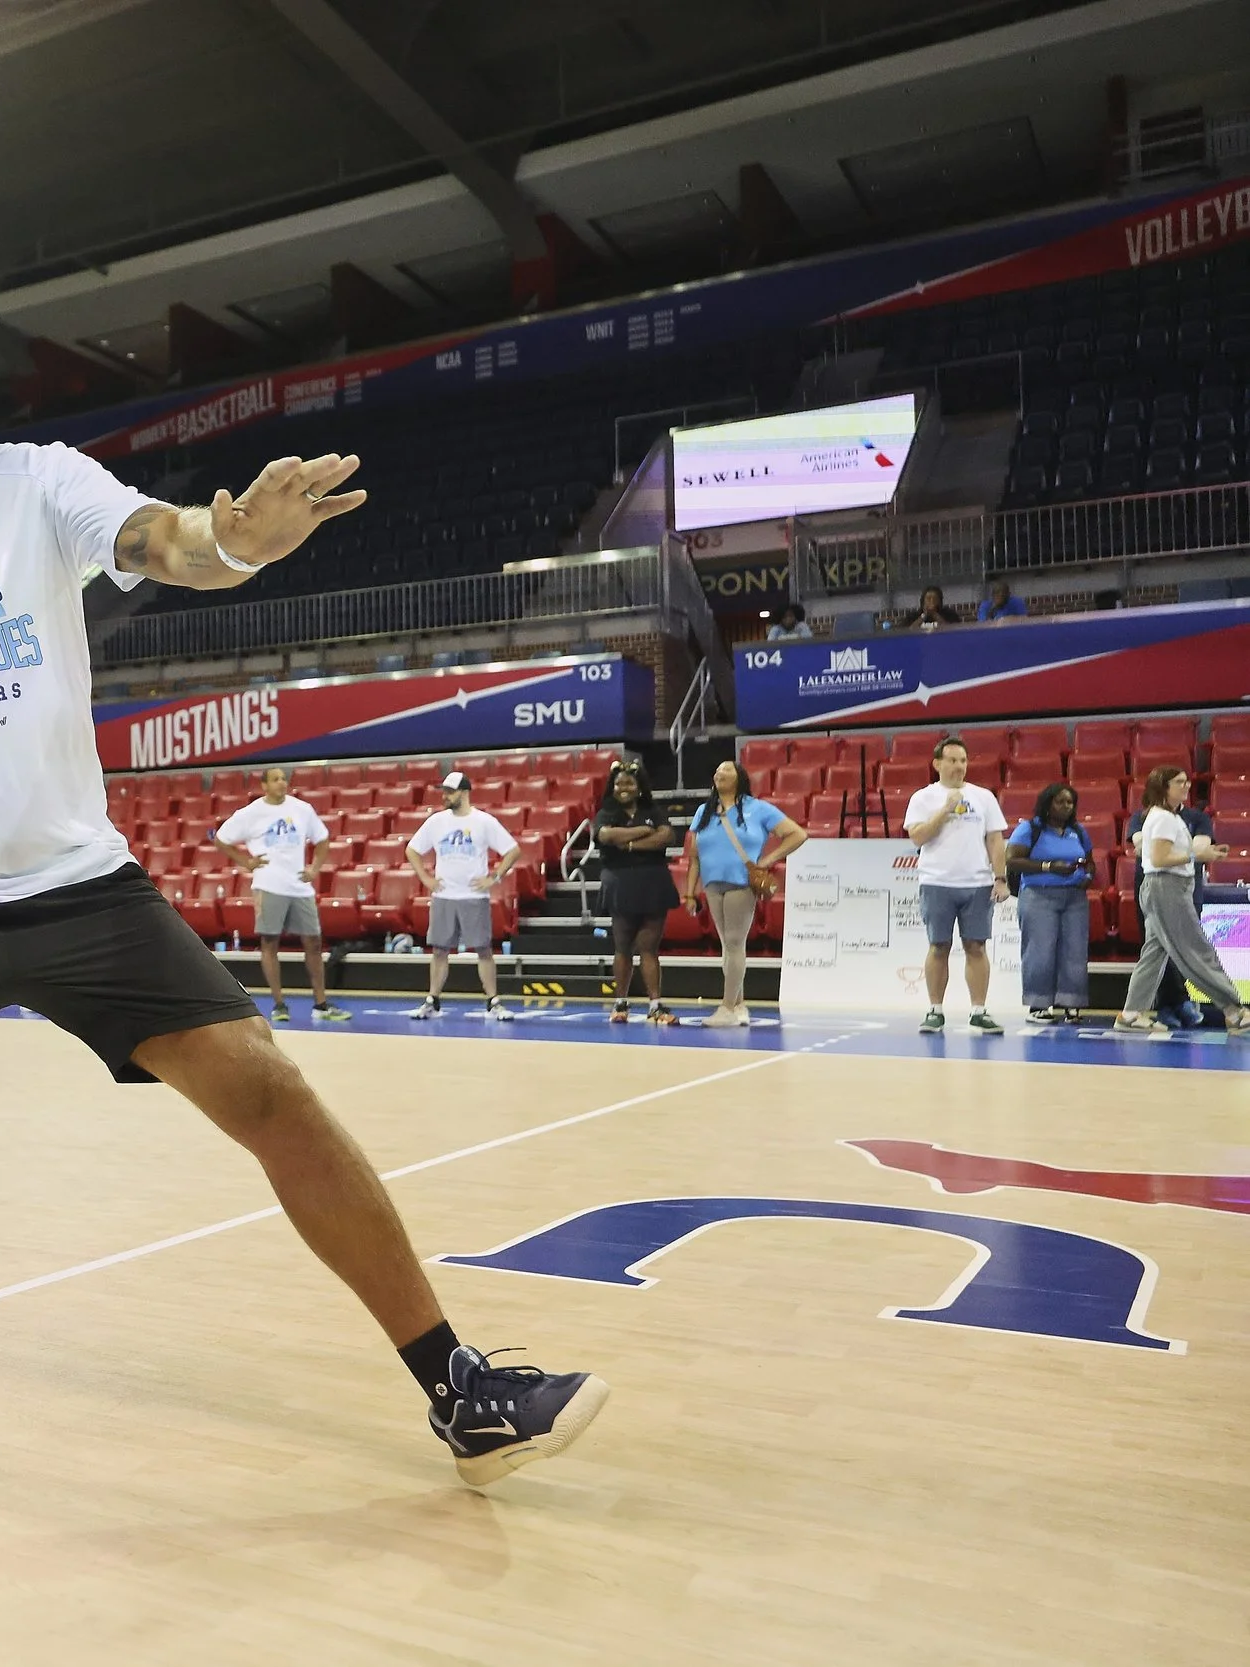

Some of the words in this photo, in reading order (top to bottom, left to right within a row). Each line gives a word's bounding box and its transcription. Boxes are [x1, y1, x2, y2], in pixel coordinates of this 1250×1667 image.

[177, 377, 276, 444] BASKETBALL
[683, 466, 774, 488] SEWELL
[745, 650, 783, 669] 104
[579, 663, 612, 682] 103
[513, 699, 585, 728] SMU
[130, 688, 278, 769] MUSTANGS
